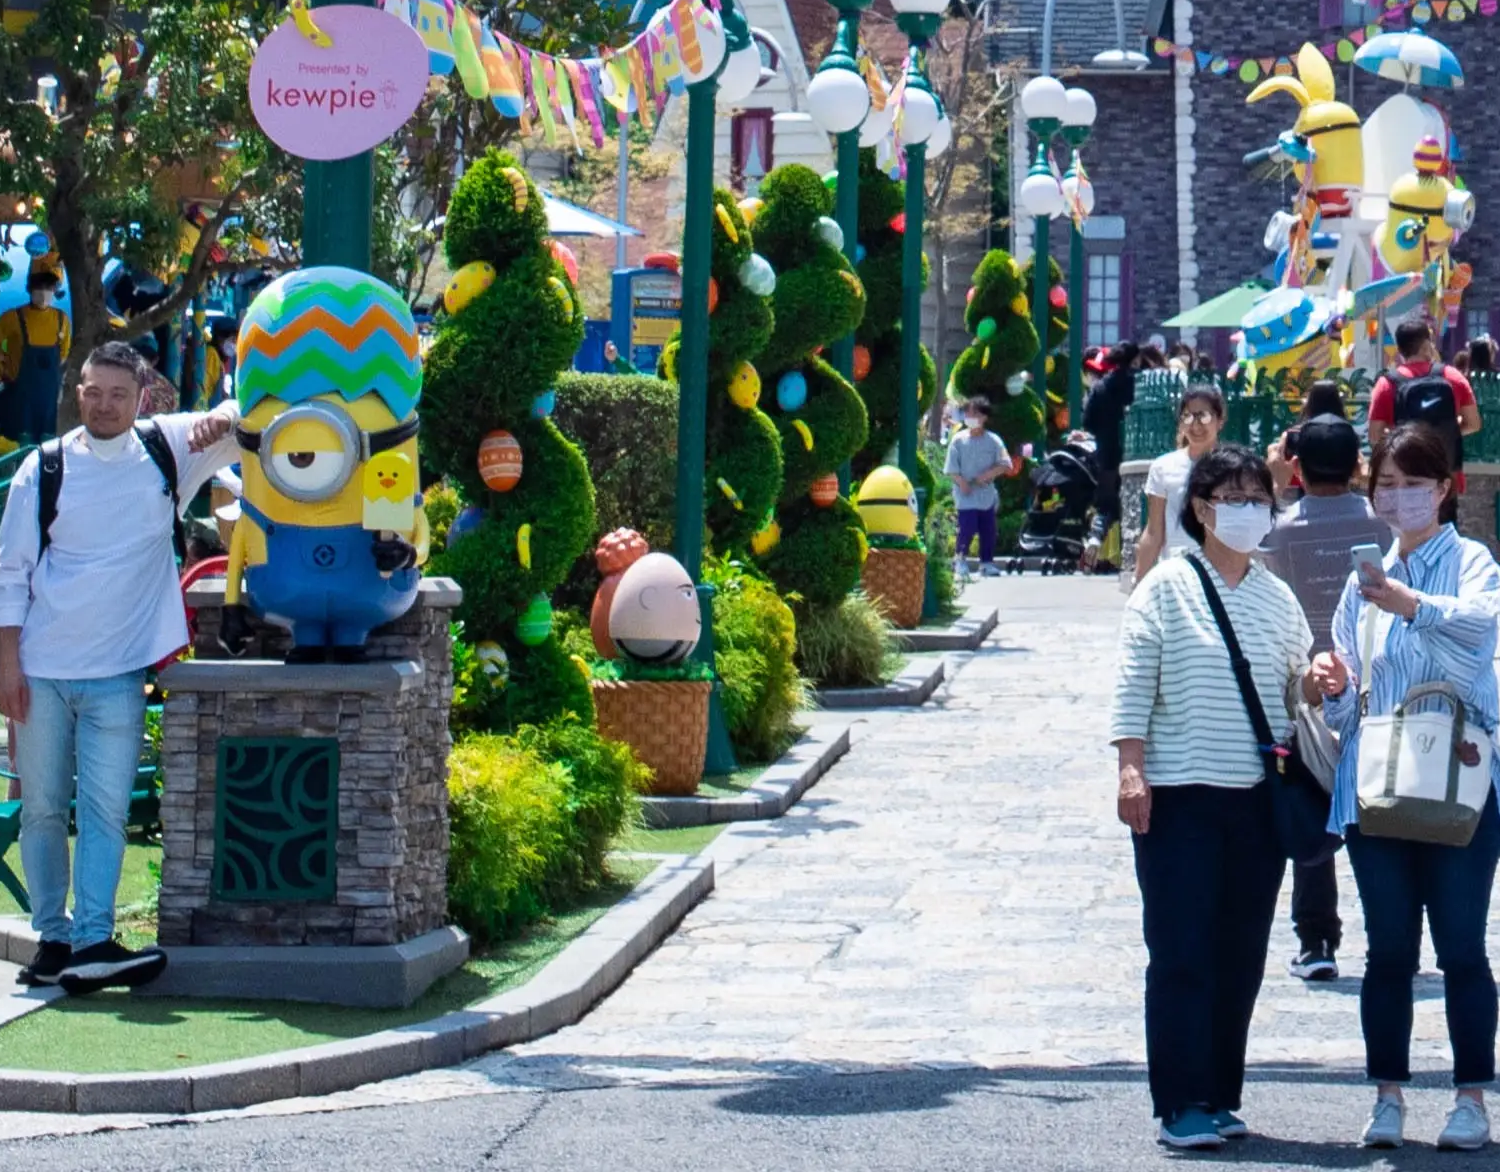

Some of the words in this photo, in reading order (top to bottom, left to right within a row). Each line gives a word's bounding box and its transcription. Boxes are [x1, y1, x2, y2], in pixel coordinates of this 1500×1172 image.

[298, 62, 350, 75] Presented
[356, 63, 370, 77] by
[267, 78, 376, 116] kewpie
